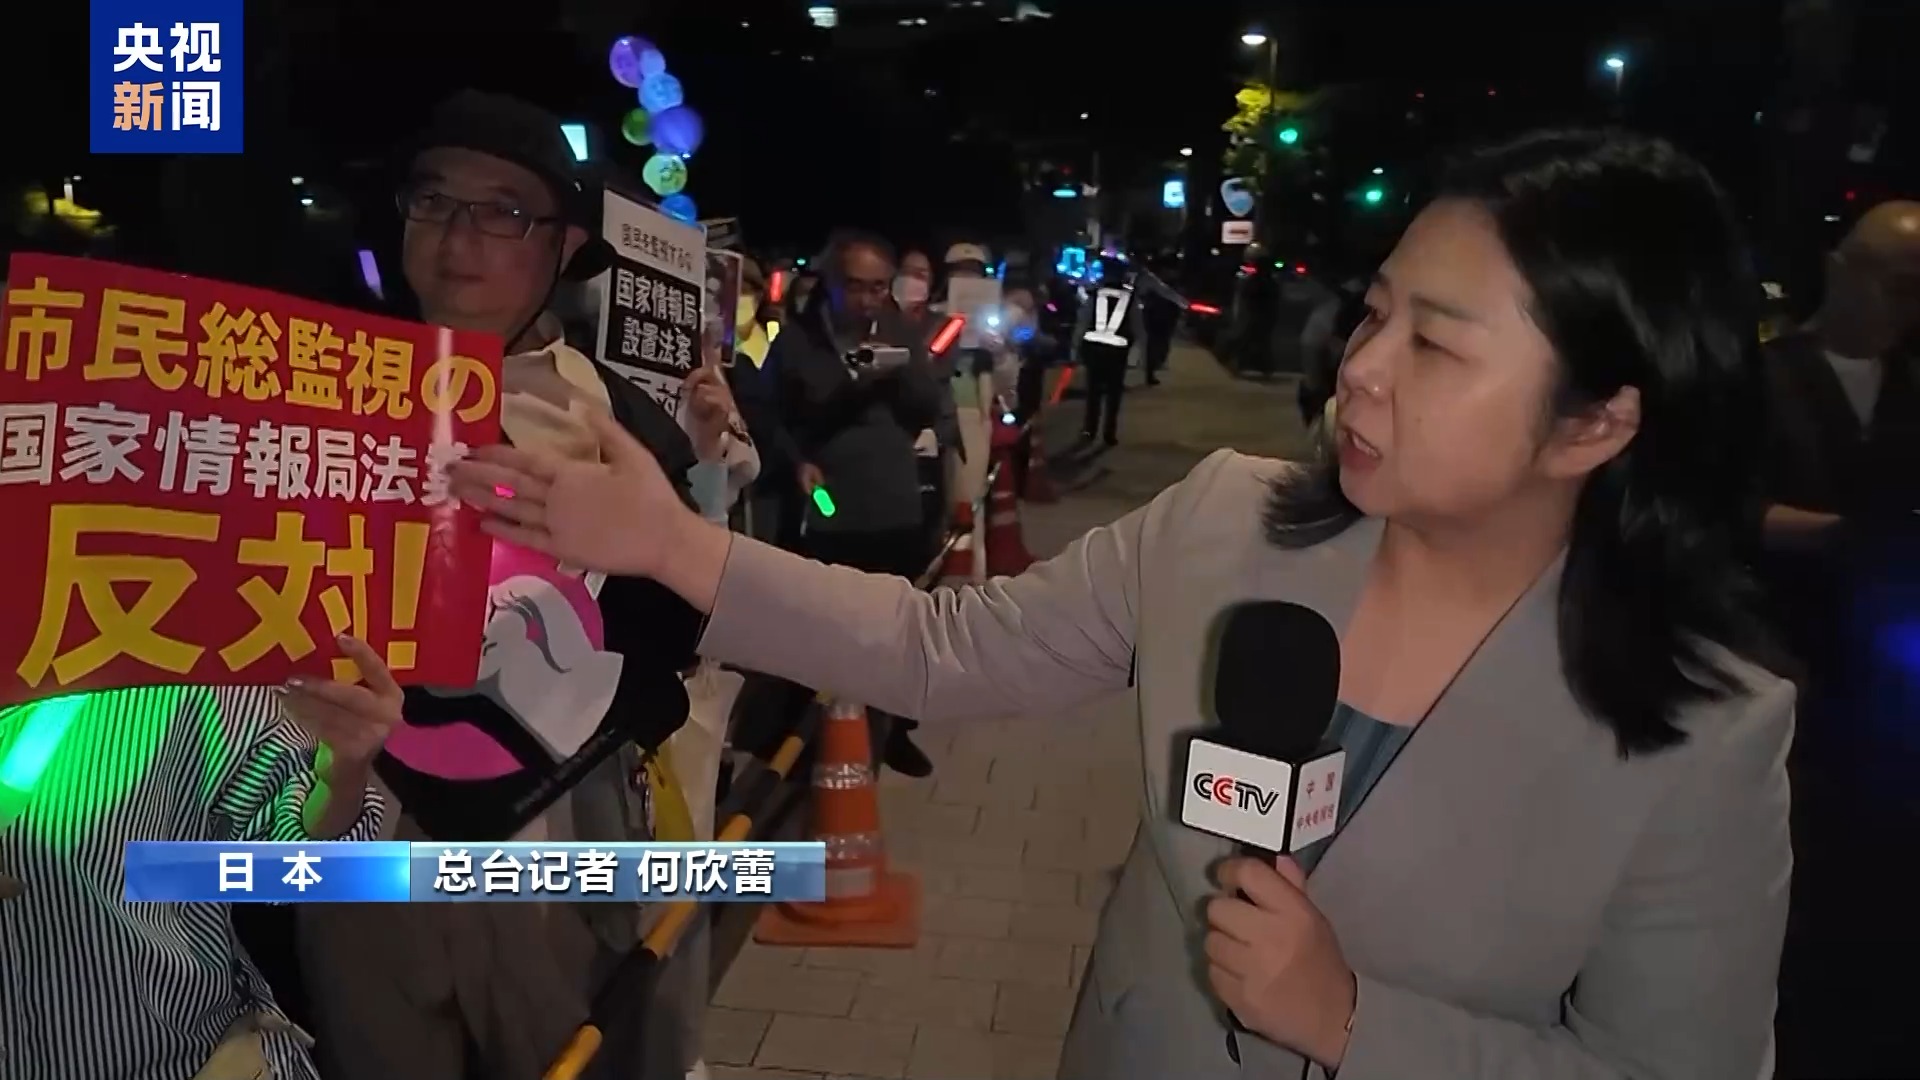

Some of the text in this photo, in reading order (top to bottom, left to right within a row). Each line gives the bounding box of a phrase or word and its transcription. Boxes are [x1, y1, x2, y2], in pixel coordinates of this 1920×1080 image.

[615, 267, 698, 331] 国家情報局
[3, 277, 497, 423] 市民総監視の
[620, 315, 692, 371] 設置法案
[17, 504, 430, 689] 反対!
[1193, 772, 1280, 817] CCTV
